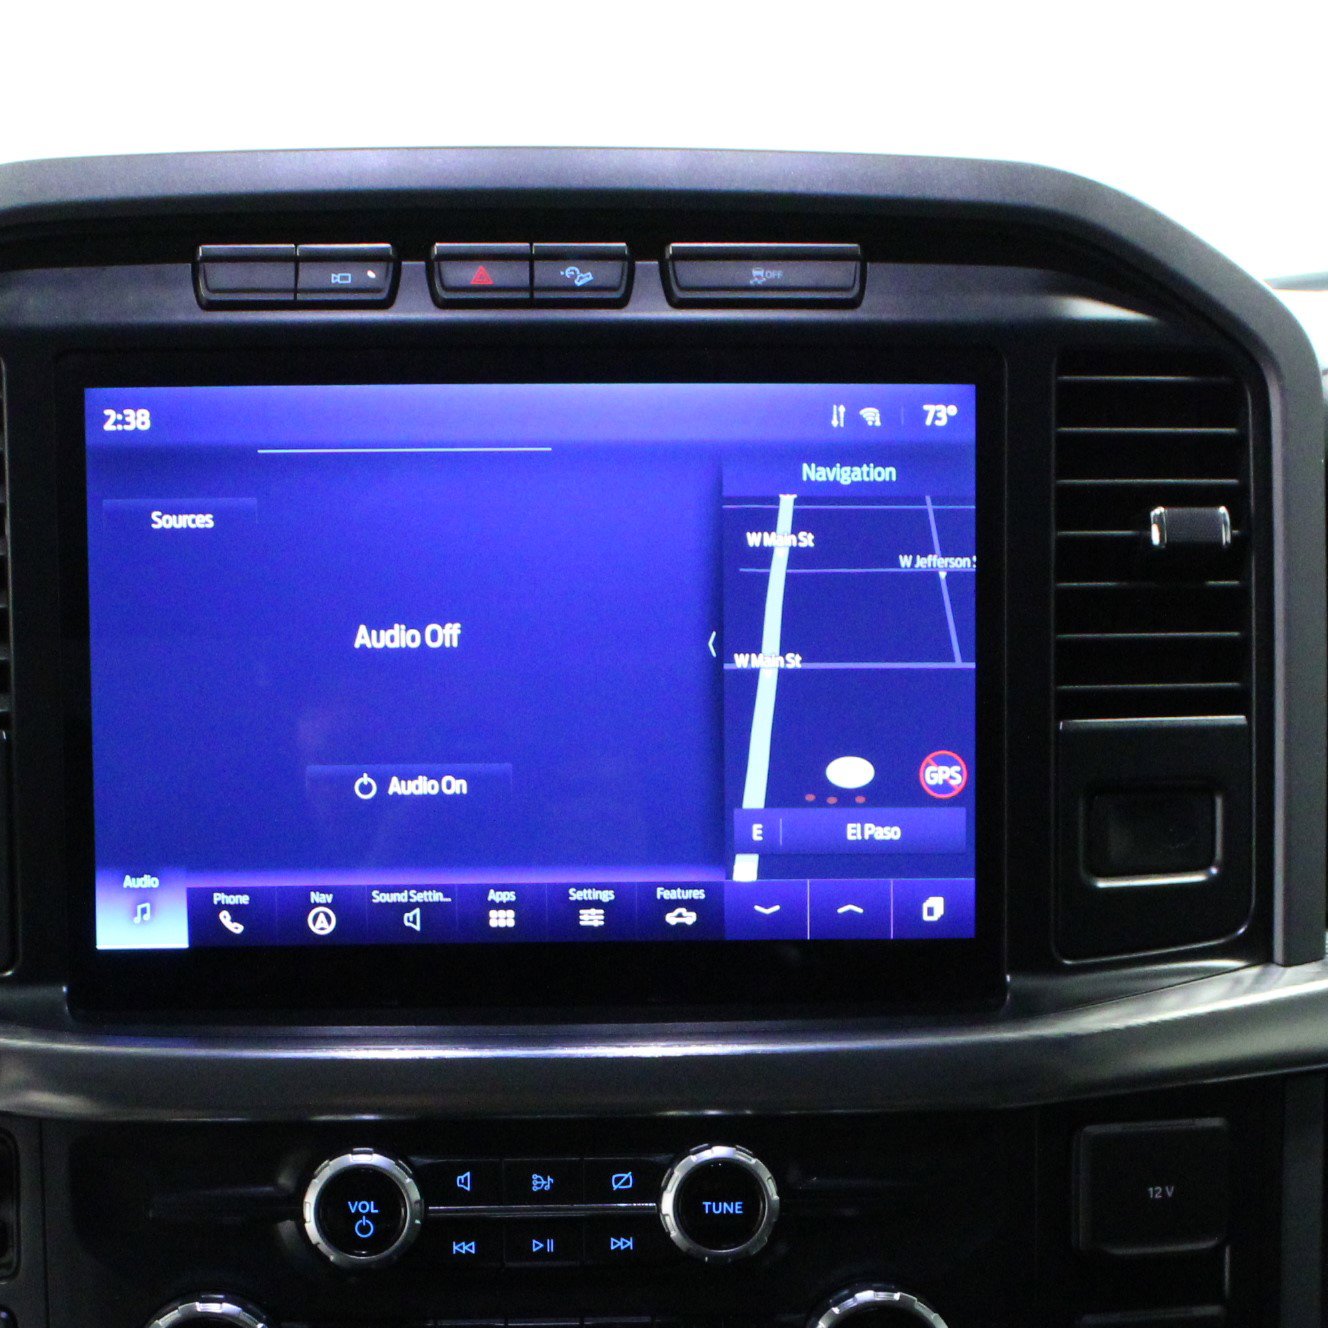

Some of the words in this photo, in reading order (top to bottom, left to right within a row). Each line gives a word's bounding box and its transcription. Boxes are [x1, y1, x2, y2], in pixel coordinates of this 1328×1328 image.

[765, 270, 783, 278] OFF
[102, 408, 151, 431] 2:38
[801, 463, 897, 484] Navigation
[150, 512, 214, 529] Sources
[746, 531, 762, 547] W
[763, 531, 797, 547] Main
[798, 531, 815, 547] St
[899, 554, 913, 568] W
[914, 554, 971, 569] Jefferson
[354, 625, 421, 649] Audio
[424, 623, 462, 648] Off
[733, 653, 750, 668] W
[751, 653, 784, 668] Main
[785, 652, 802, 668] St
[924, 765, 962, 785] GPS
[388, 775, 440, 796] Audio
[441, 775, 468, 795] On
[752, 824, 763, 841] E
[846, 823, 862, 841] El
[864, 823, 901, 841] Paso
[123, 874, 159, 889] Audio
[213, 891, 249, 906] Phone
[310, 891, 333, 904] Nav
[372, 890, 408, 904] Sound
[488, 889, 516, 903] Apps
[569, 888, 615, 902] Settings
[656, 887, 706, 901] Features
[1147, 1186, 1162, 1199] 12
[1164, 1186, 1175, 1199] V
[347, 1201, 379, 1214] VOL
[702, 1201, 743, 1215] TUNE
